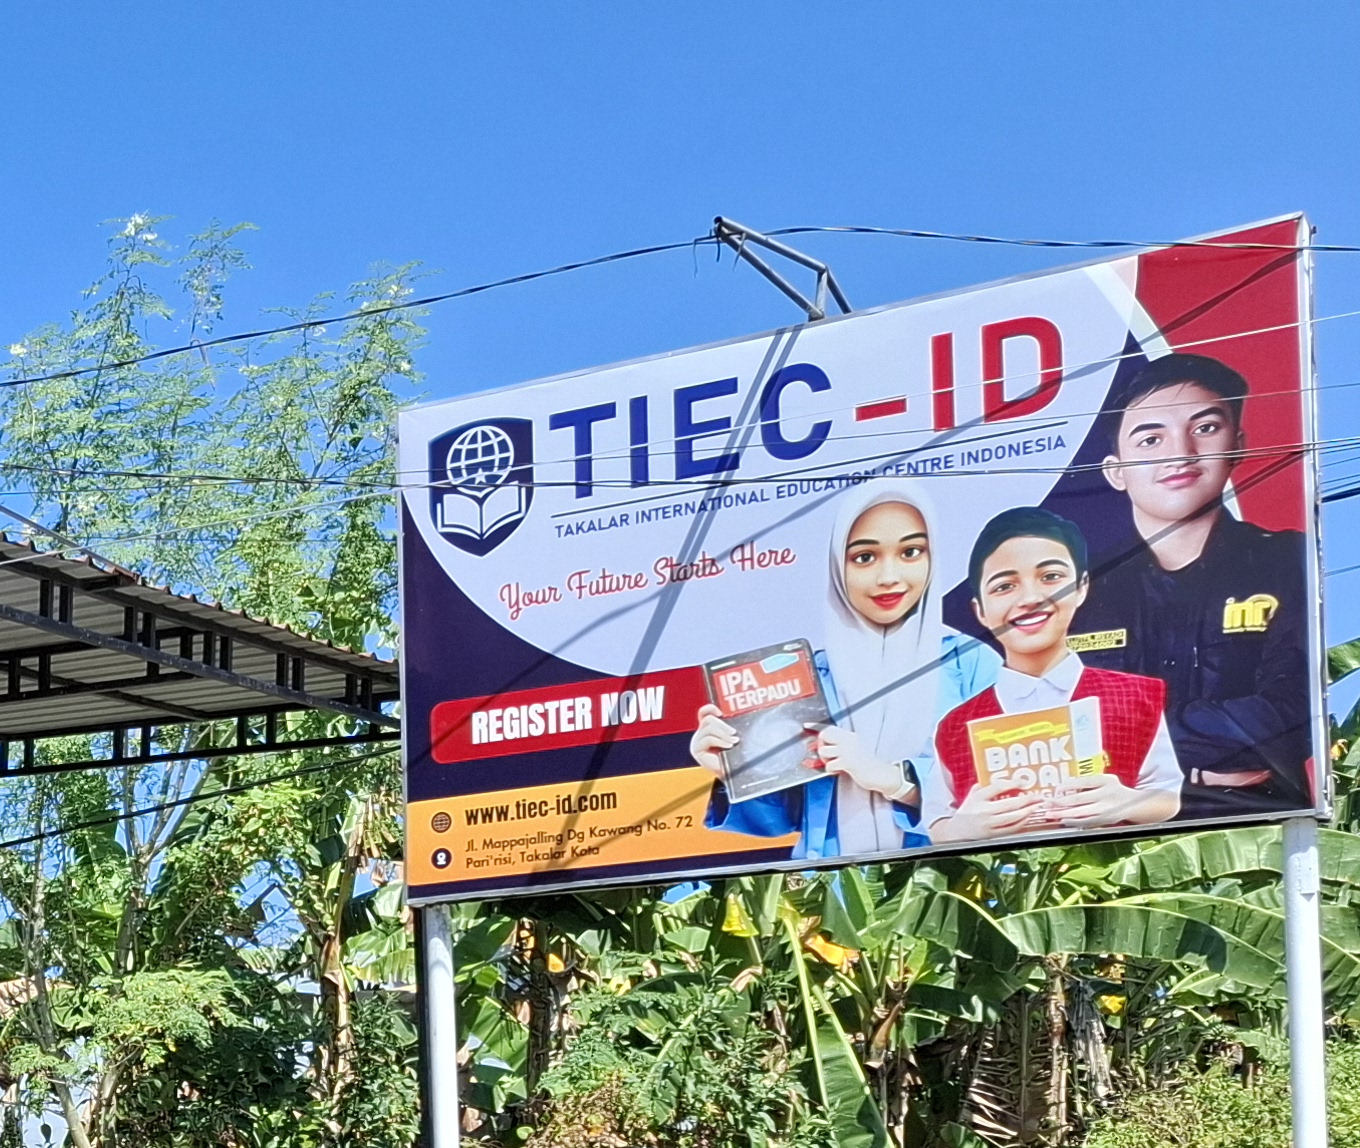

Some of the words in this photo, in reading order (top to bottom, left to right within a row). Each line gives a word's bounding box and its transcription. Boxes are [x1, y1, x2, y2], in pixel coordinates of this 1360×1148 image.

[549, 316, 1064, 499] TIEC-ID
[555, 513, 630, 538] TAKALAR
[635, 488, 770, 526] INTERNATIONAL
[776, 468, 877, 498] EDUCATION
[882, 454, 955, 477] CENTRE
[961, 434, 1066, 467] INDONESIA
[499, 582, 563, 621] Your
[567, 567, 648, 600] Future
[653, 551, 724, 586] Starts
[730, 540, 797, 571] Here
[719, 668, 759, 697] IPA
[724, 678, 802, 712] TERPADU
[471, 696, 593, 744] REGISTER
[600, 685, 665, 728] NOW
[983, 735, 1073, 772] BANK
[464, 791, 618, 826] www.tiec-id.com
[482, 831, 564, 850] Mappajalling
[568, 828, 585, 843] Dg
[589, 823, 643, 839] Kawang
[647, 819, 671, 832] No.
[675, 815, 694, 828] 72
[520, 848, 566, 863] Takalar
[571, 845, 600, 858] Kota
